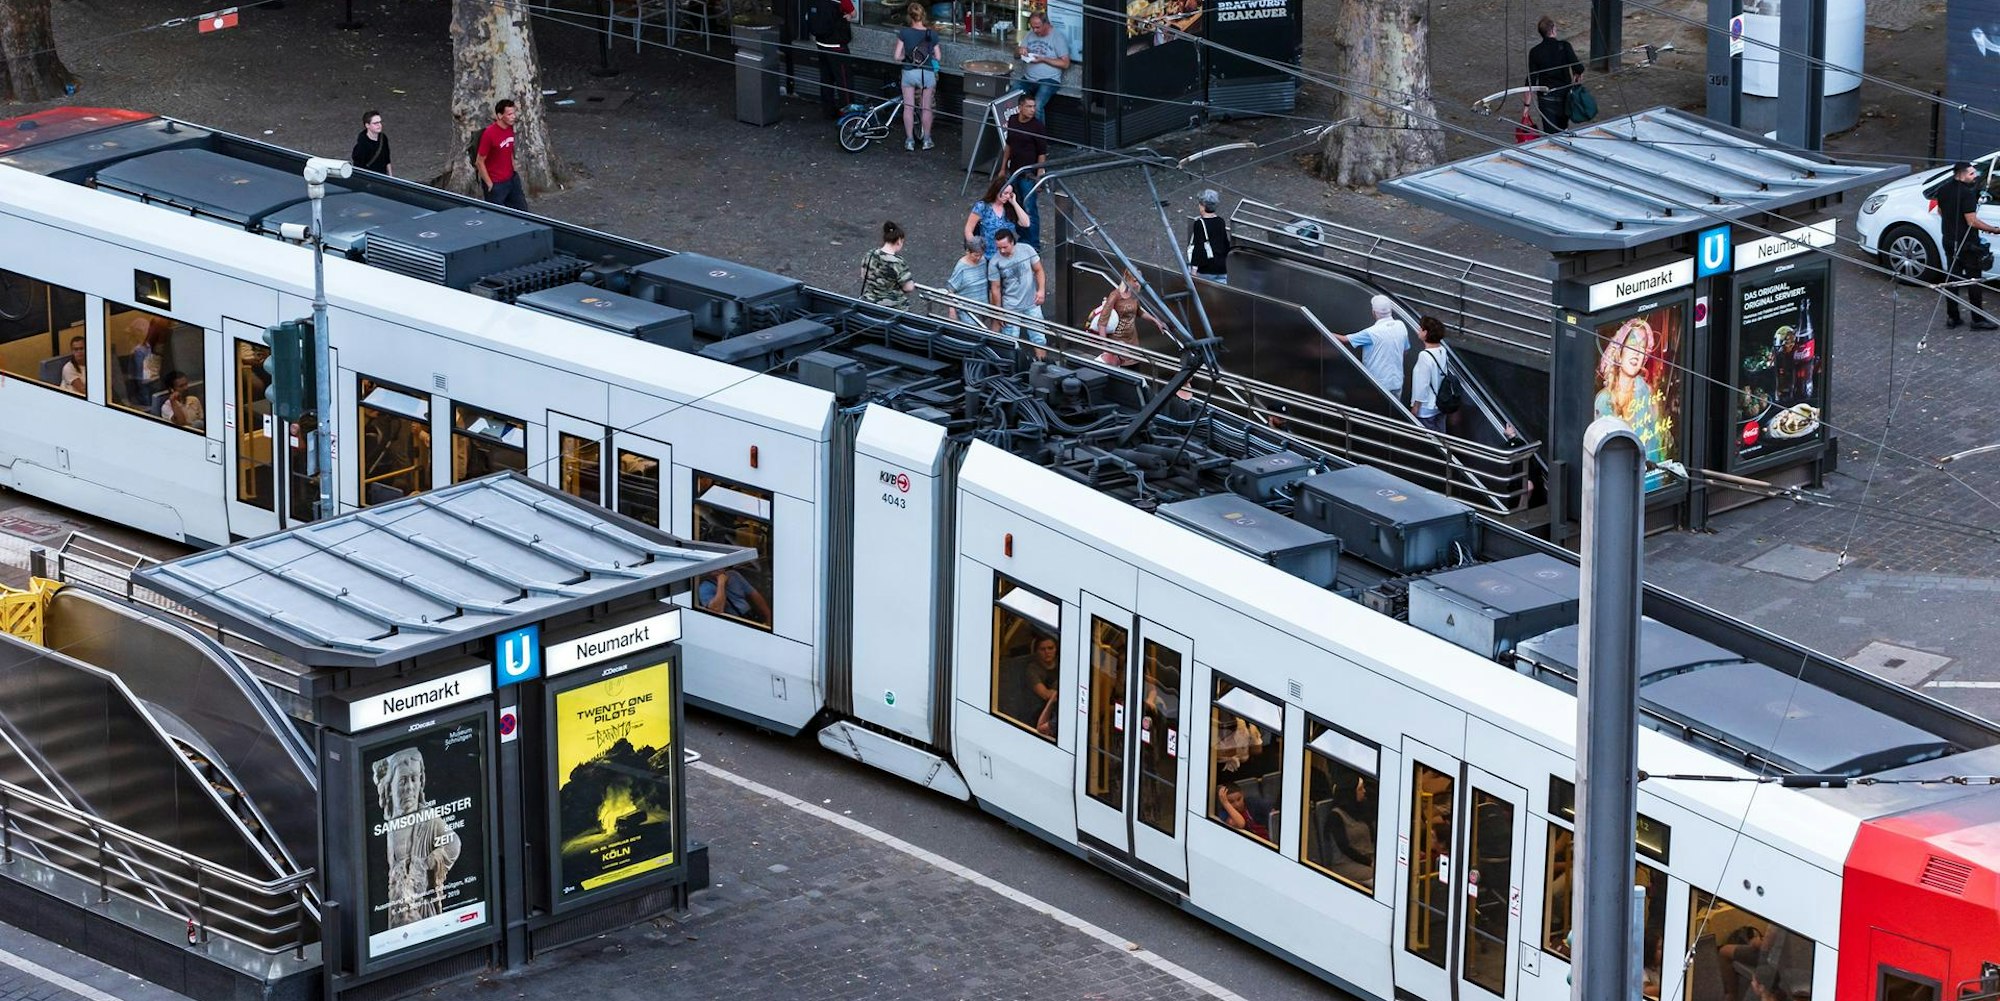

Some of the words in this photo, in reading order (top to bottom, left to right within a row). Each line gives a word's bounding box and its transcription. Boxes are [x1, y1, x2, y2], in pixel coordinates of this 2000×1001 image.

[1217, 7, 1288, 22] KRAKAUER
[1704, 233, 1724, 270] U
[1758, 231, 1811, 259] Neumarkt
[1616, 270, 1673, 298] Neumarkt
[1743, 290, 1758, 301] DAS
[1757, 282, 1791, 297] ORIGINAL,
[1743, 296, 1775, 311] ORIGINAL
[1774, 286, 1806, 302] SERVIERT.
[879, 470, 898, 486] KVB
[881, 492, 906, 509] 4043
[505, 632, 531, 676] U
[576, 625, 650, 660] Neumarkt
[383, 680, 460, 715] Neumarkt
[577, 700, 626, 720] TWENTY
[628, 692, 653, 707] ØNE
[594, 706, 636, 724] PILØTS
[373, 797, 472, 837] SAMSONMEISTER
[444, 819, 465, 832] SEINE
[434, 833, 455, 847] ZEIT
[602, 846, 631, 862] KÖLN
